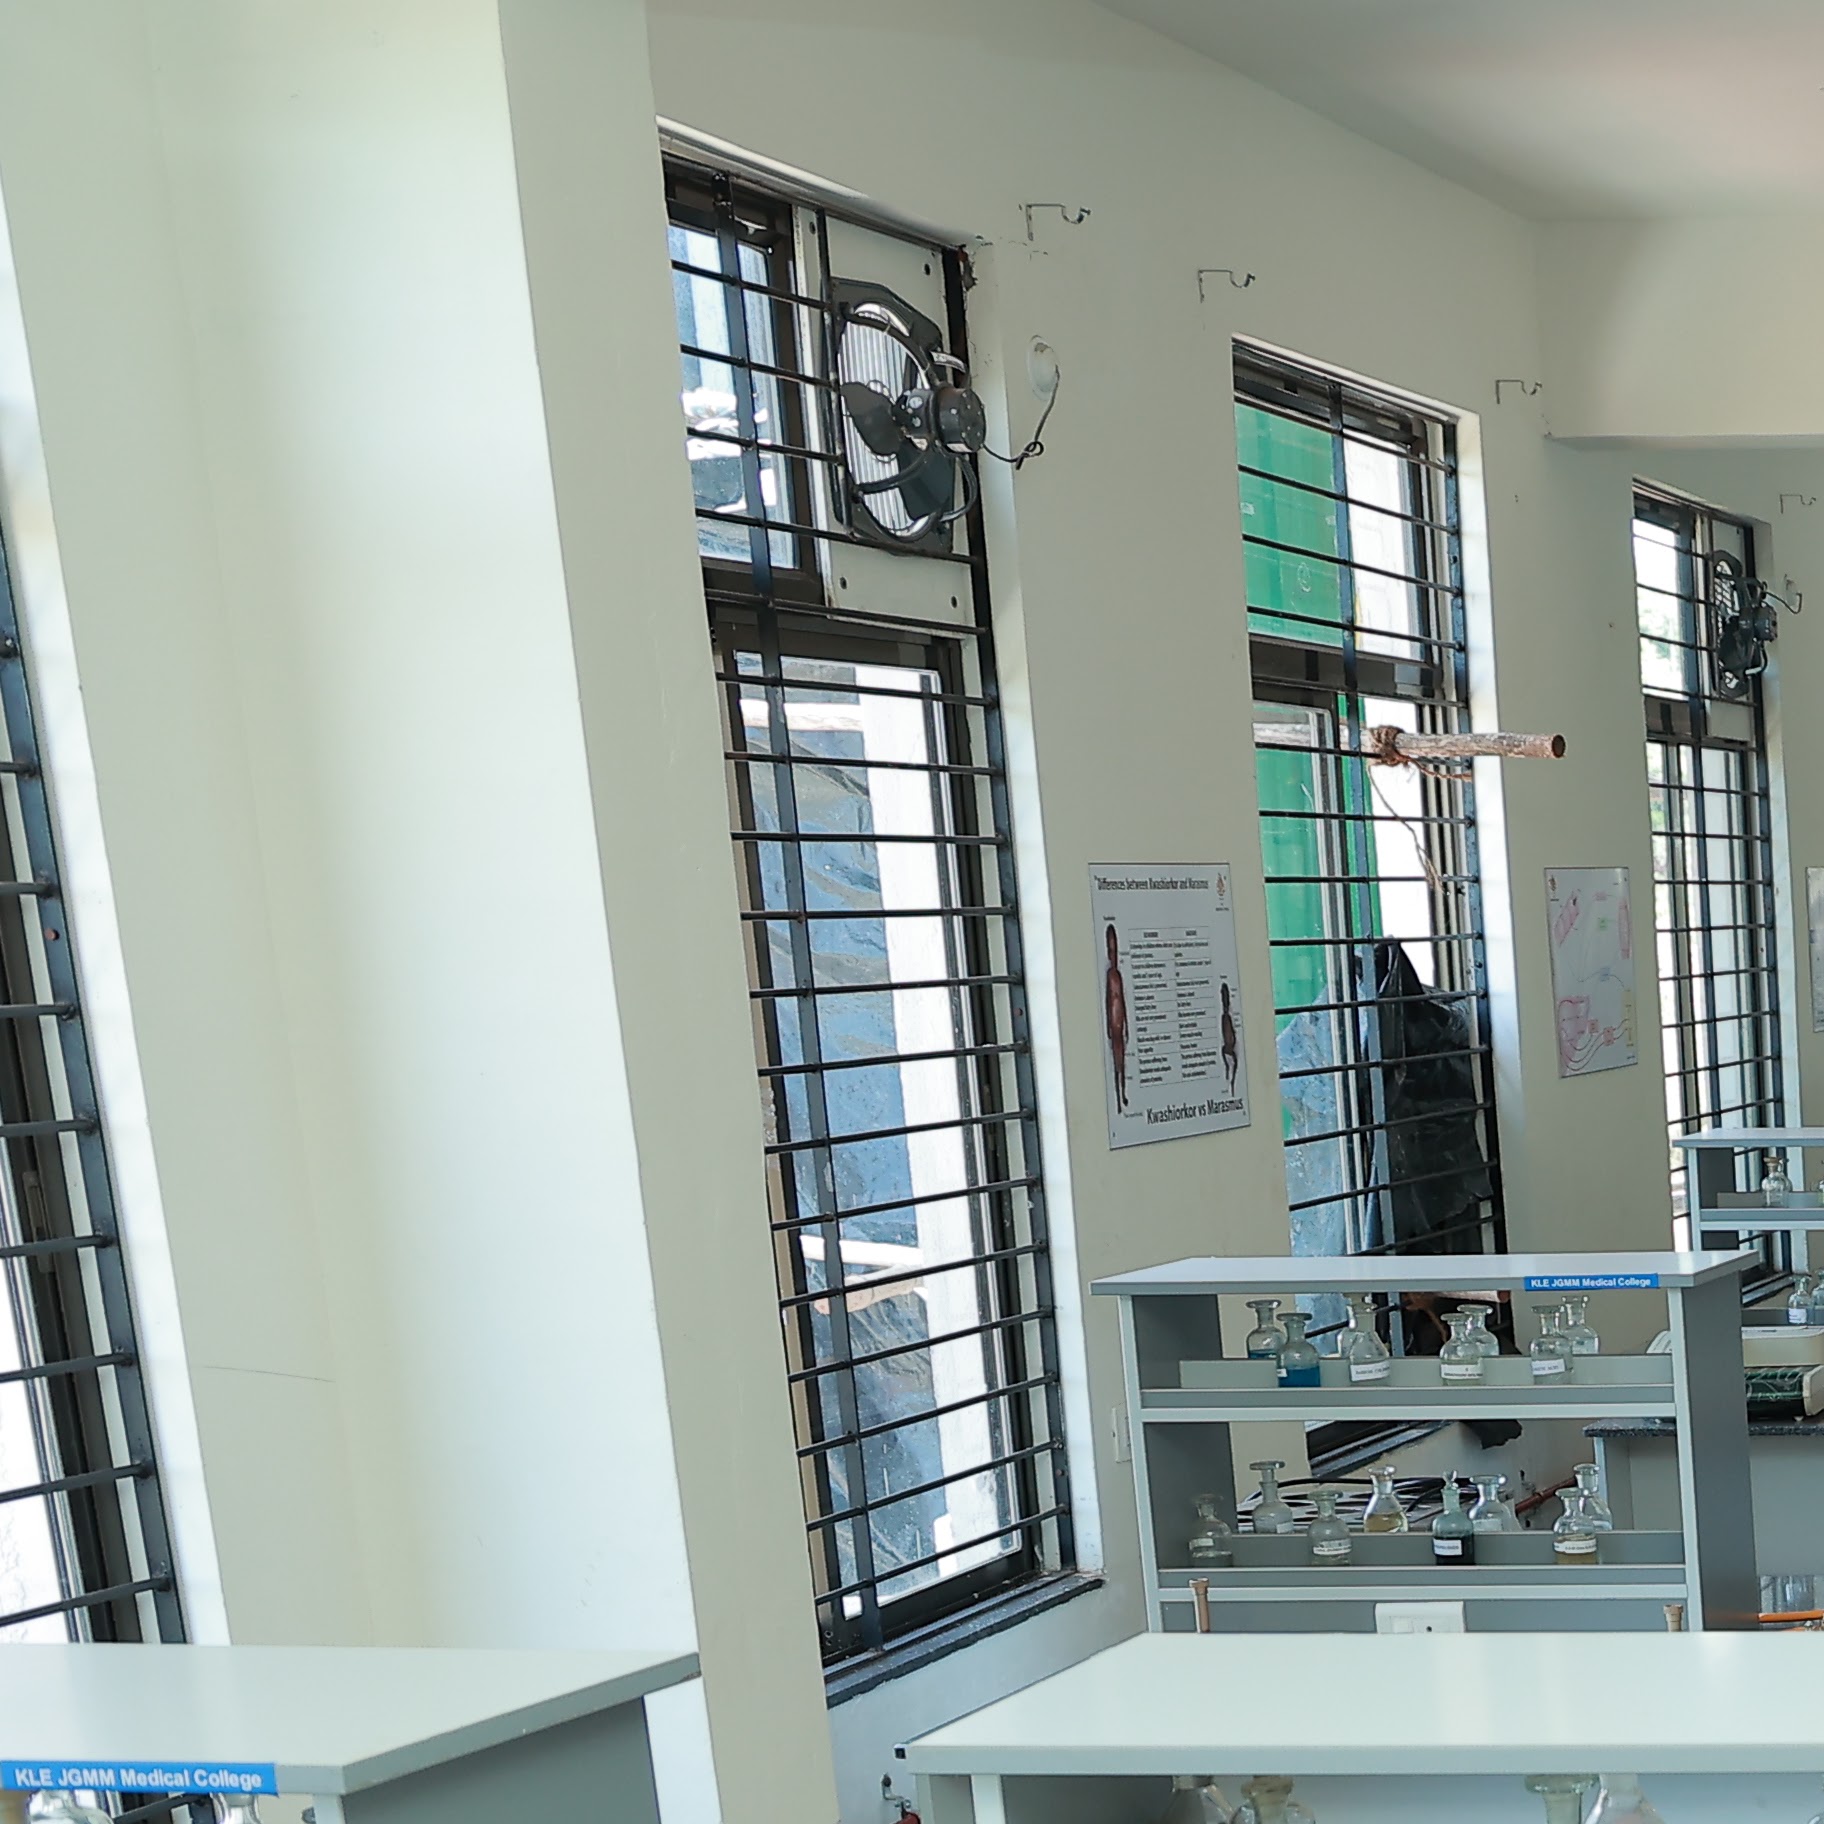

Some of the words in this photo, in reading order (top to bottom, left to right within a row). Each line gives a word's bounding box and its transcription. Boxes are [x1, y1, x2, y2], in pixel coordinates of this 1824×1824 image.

[1147, 1102, 1196, 1125] Kwashiorkor
[1198, 1105, 1206, 1117] vs
[1207, 1098, 1244, 1115] Marasmus
[1531, 1280, 1549, 1288] KLE
[1551, 1279, 1580, 1288] JGMM
[1582, 1278, 1617, 1286] Medical
[1618, 1277, 1651, 1287] College
[14, 1769, 53, 1787] KLE
[58, 1769, 115, 1788] JGMM
[120, 1768, 190, 1787] Medical
[193, 1769, 262, 1791] College
